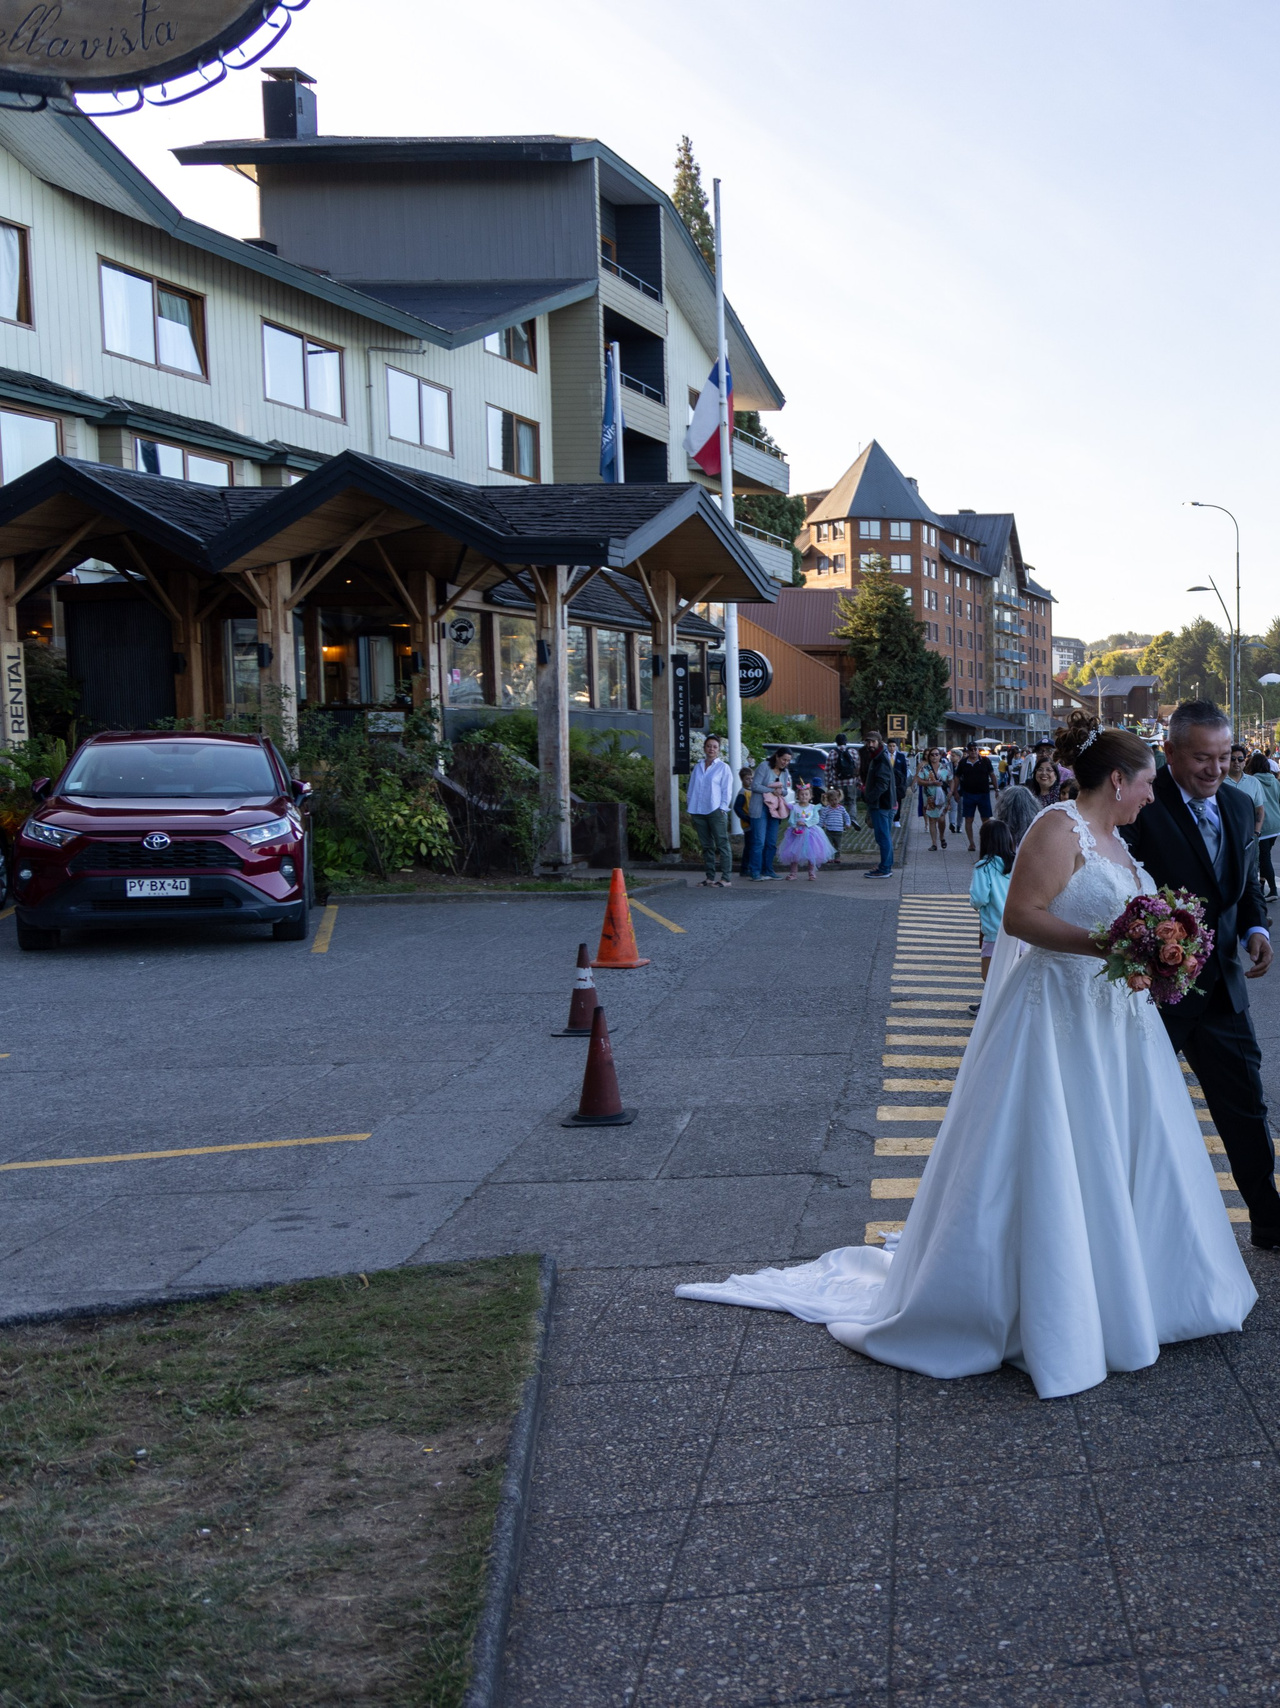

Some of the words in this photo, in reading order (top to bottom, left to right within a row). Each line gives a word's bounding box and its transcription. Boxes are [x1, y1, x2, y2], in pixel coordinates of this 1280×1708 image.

[7, 647, 25, 734] RENTAL
[678, 685, 686, 748] RECEPCIÓN
[893, 717, 902, 729] E
